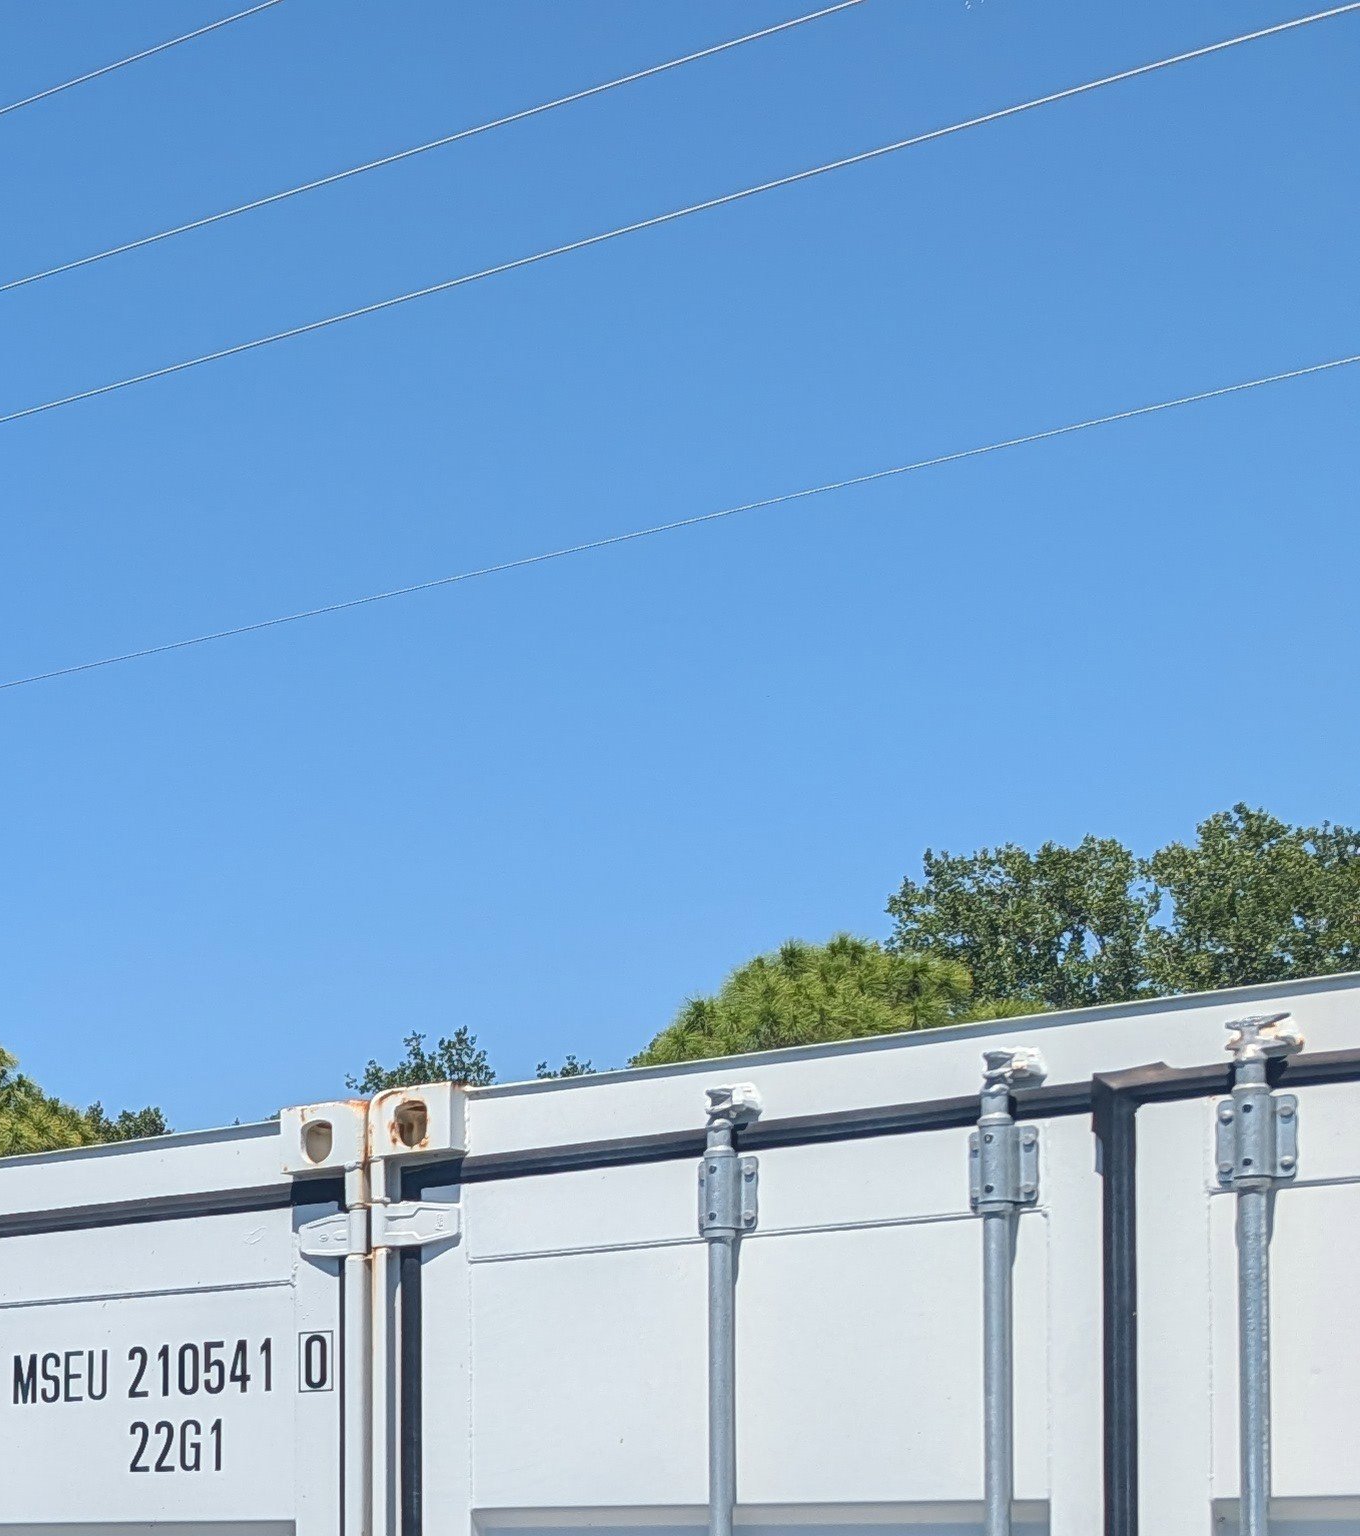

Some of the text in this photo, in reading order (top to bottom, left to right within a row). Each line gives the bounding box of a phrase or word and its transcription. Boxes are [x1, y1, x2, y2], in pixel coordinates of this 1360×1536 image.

[12, 1334, 328, 1405] MSEU 210541 0
[129, 1418, 223, 1473] 22G1
